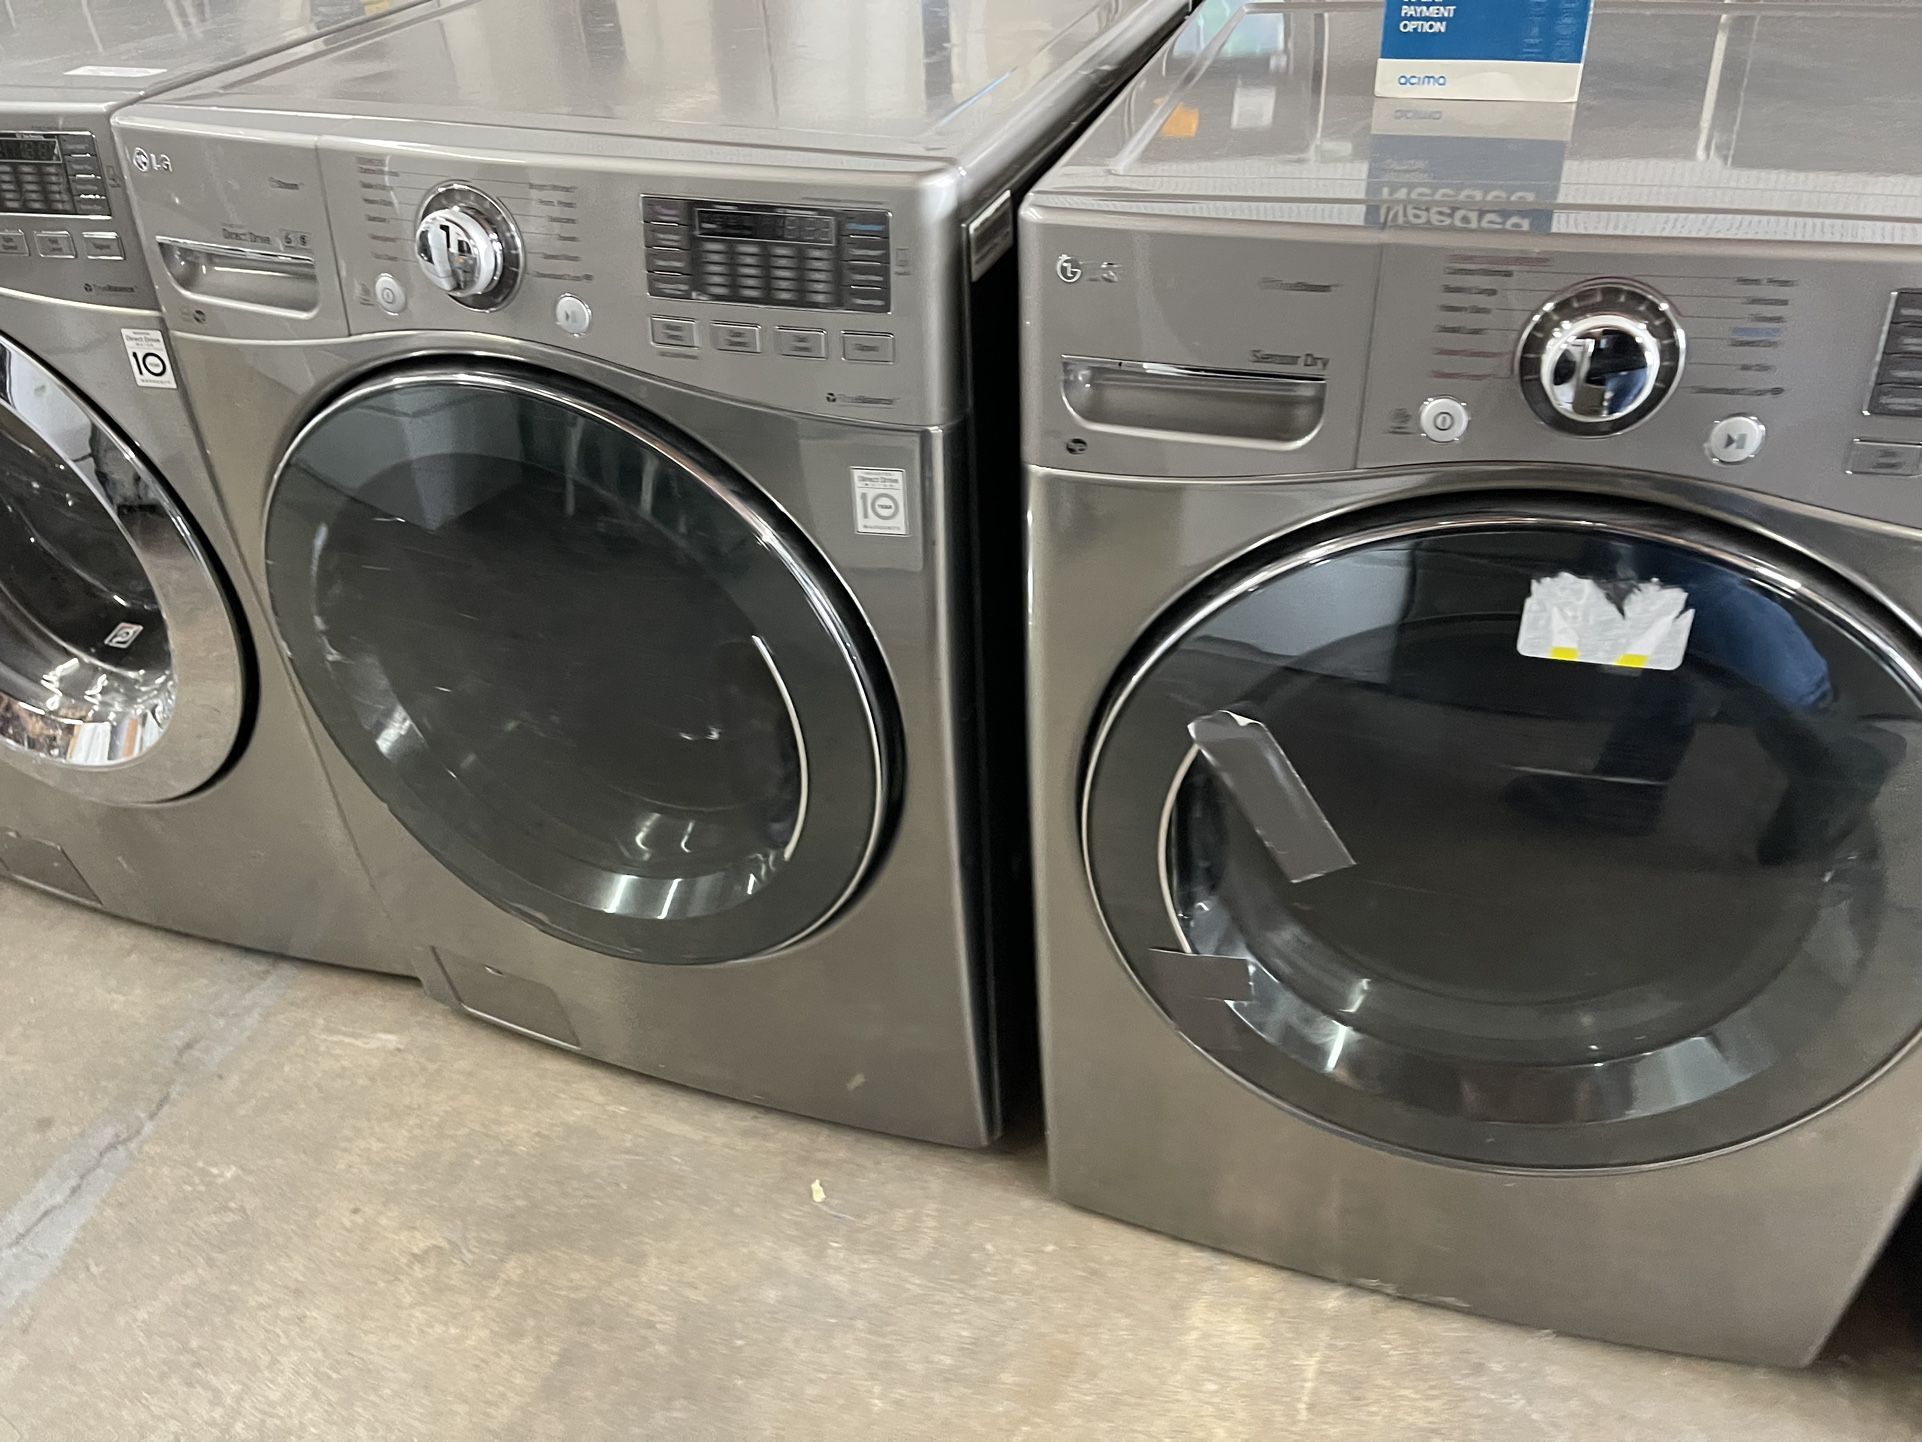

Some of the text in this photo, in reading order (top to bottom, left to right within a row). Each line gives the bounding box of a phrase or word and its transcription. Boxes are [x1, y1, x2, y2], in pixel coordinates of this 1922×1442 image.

[1400, 5, 1456, 18] PAYMENT
[1399, 20, 1447, 33] OPTION
[1398, 74, 1447, 86] acima
[132, 351, 167, 377] 10
[1303, 353, 1331, 370] Dry
[860, 492, 900, 521] 10
